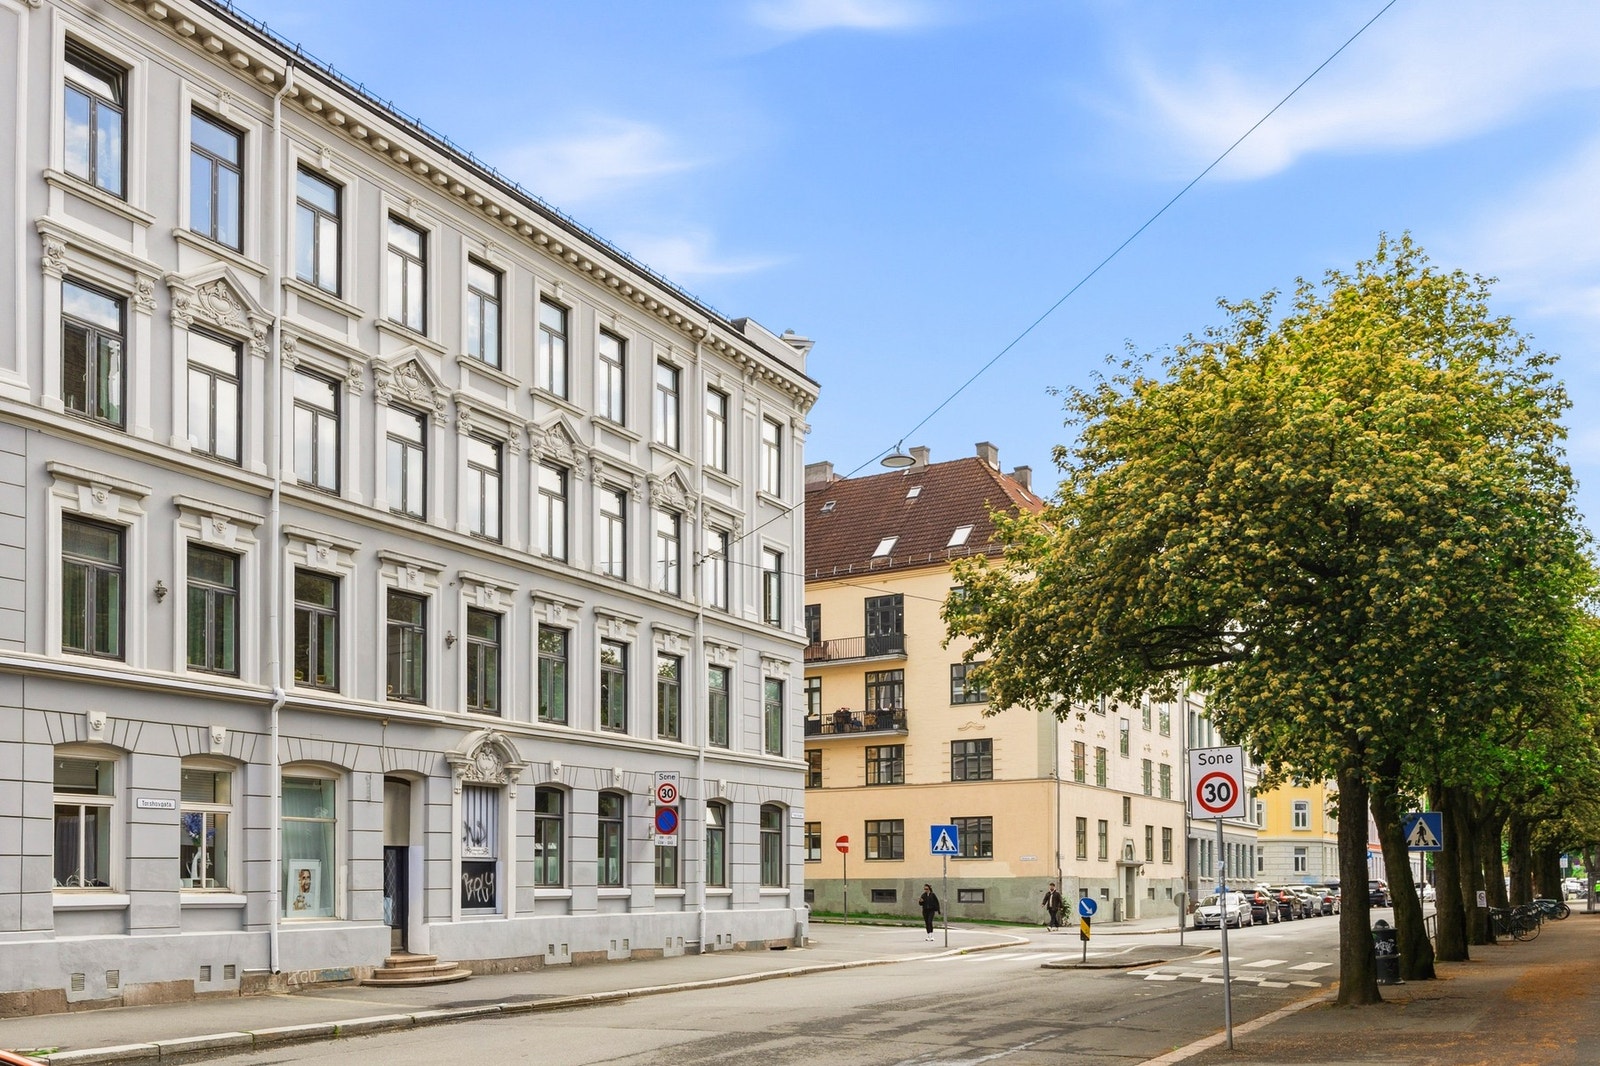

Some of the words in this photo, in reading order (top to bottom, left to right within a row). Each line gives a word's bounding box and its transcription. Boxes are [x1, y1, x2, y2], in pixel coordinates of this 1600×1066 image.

[1198, 753, 1233, 766] Sone
[661, 788, 673, 798] 30
[1204, 782, 1231, 803] 30
